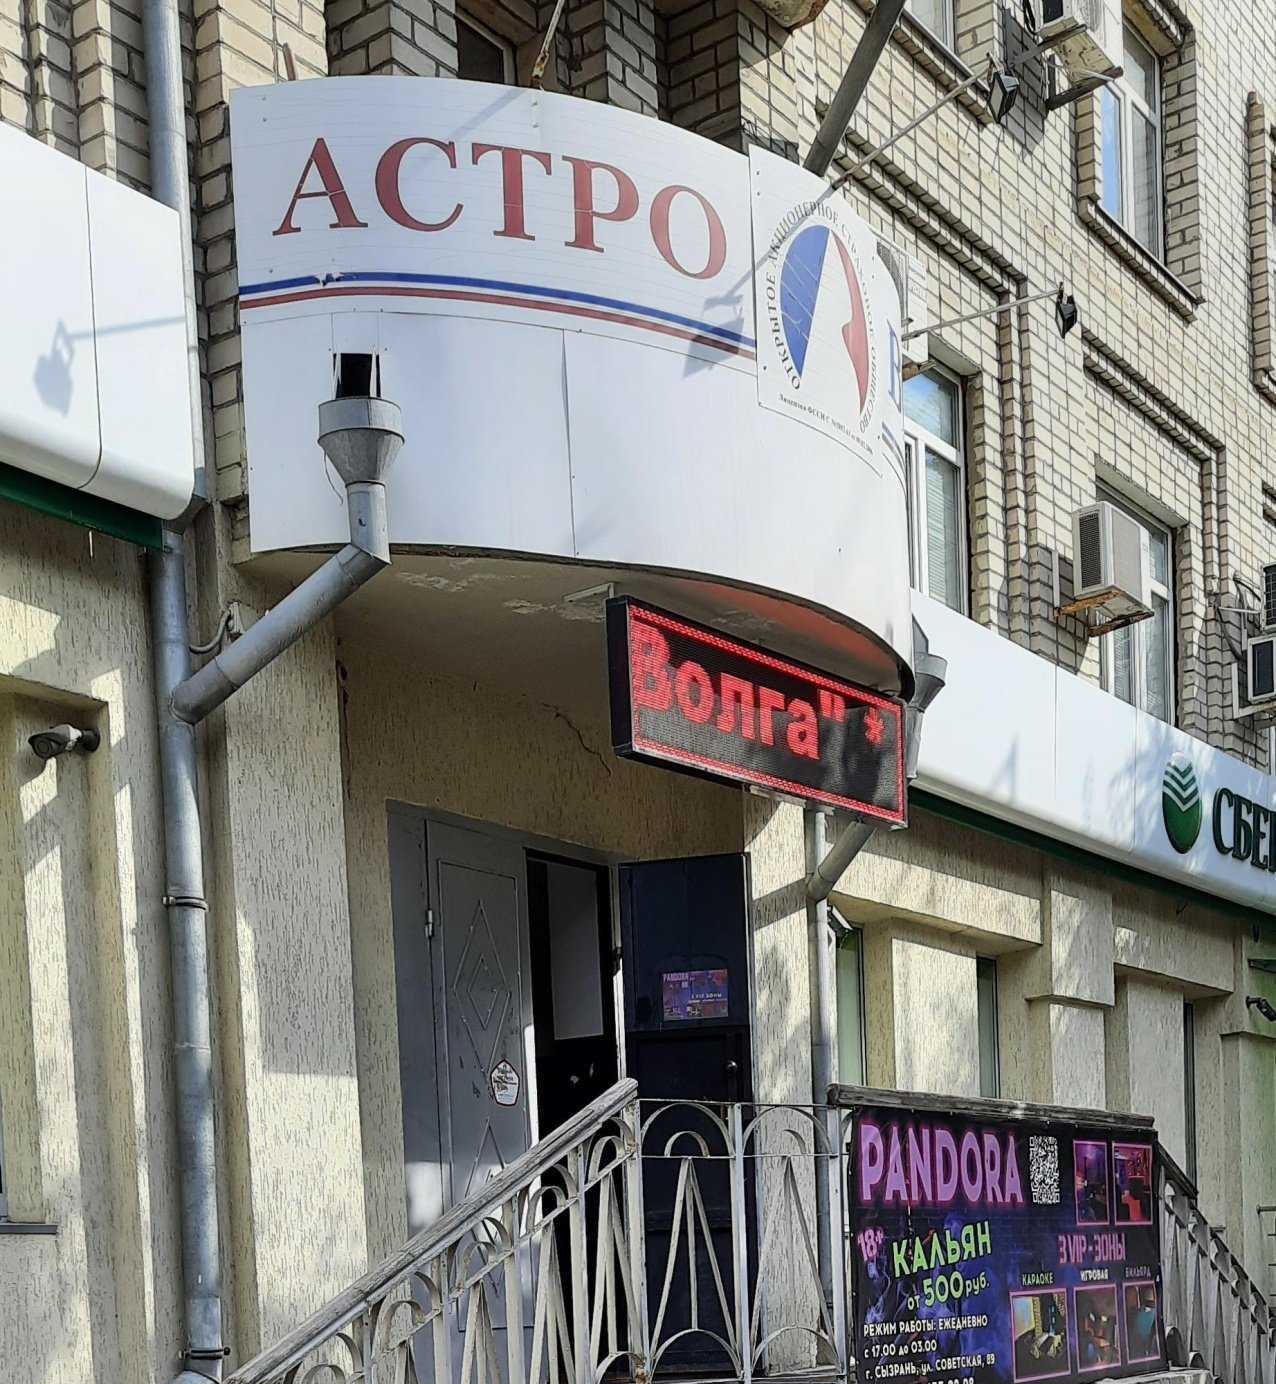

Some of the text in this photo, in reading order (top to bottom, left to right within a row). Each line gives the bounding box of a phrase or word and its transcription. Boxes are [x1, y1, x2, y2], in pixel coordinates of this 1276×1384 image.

[272, 137, 727, 281] АСТРО
[766, 271, 801, 390] ОТКРЫТОЕ
[860, 1123, 1024, 1203] PANDORA
[892, 1221, 992, 1278] КАЛЬЯН
[1022, 1272, 1054, 1286] КАРАОКЕ
[1080, 1268, 1109, 1281] ИГРОВАЯ
[908, 1294, 920, 1310] от
[923, 1271, 964, 1307] 500
[864, 1315, 988, 1337] РЕЖИМ РАБОТЫ: ЕЖЕДНЕВНО
[864, 1340, 937, 1358] с 17.00 до 03.00
[875, 1361, 919, 1378] СЫЗРАНЬ,
[935, 1355, 985, 1371] СОВЕТСКАЯ,
